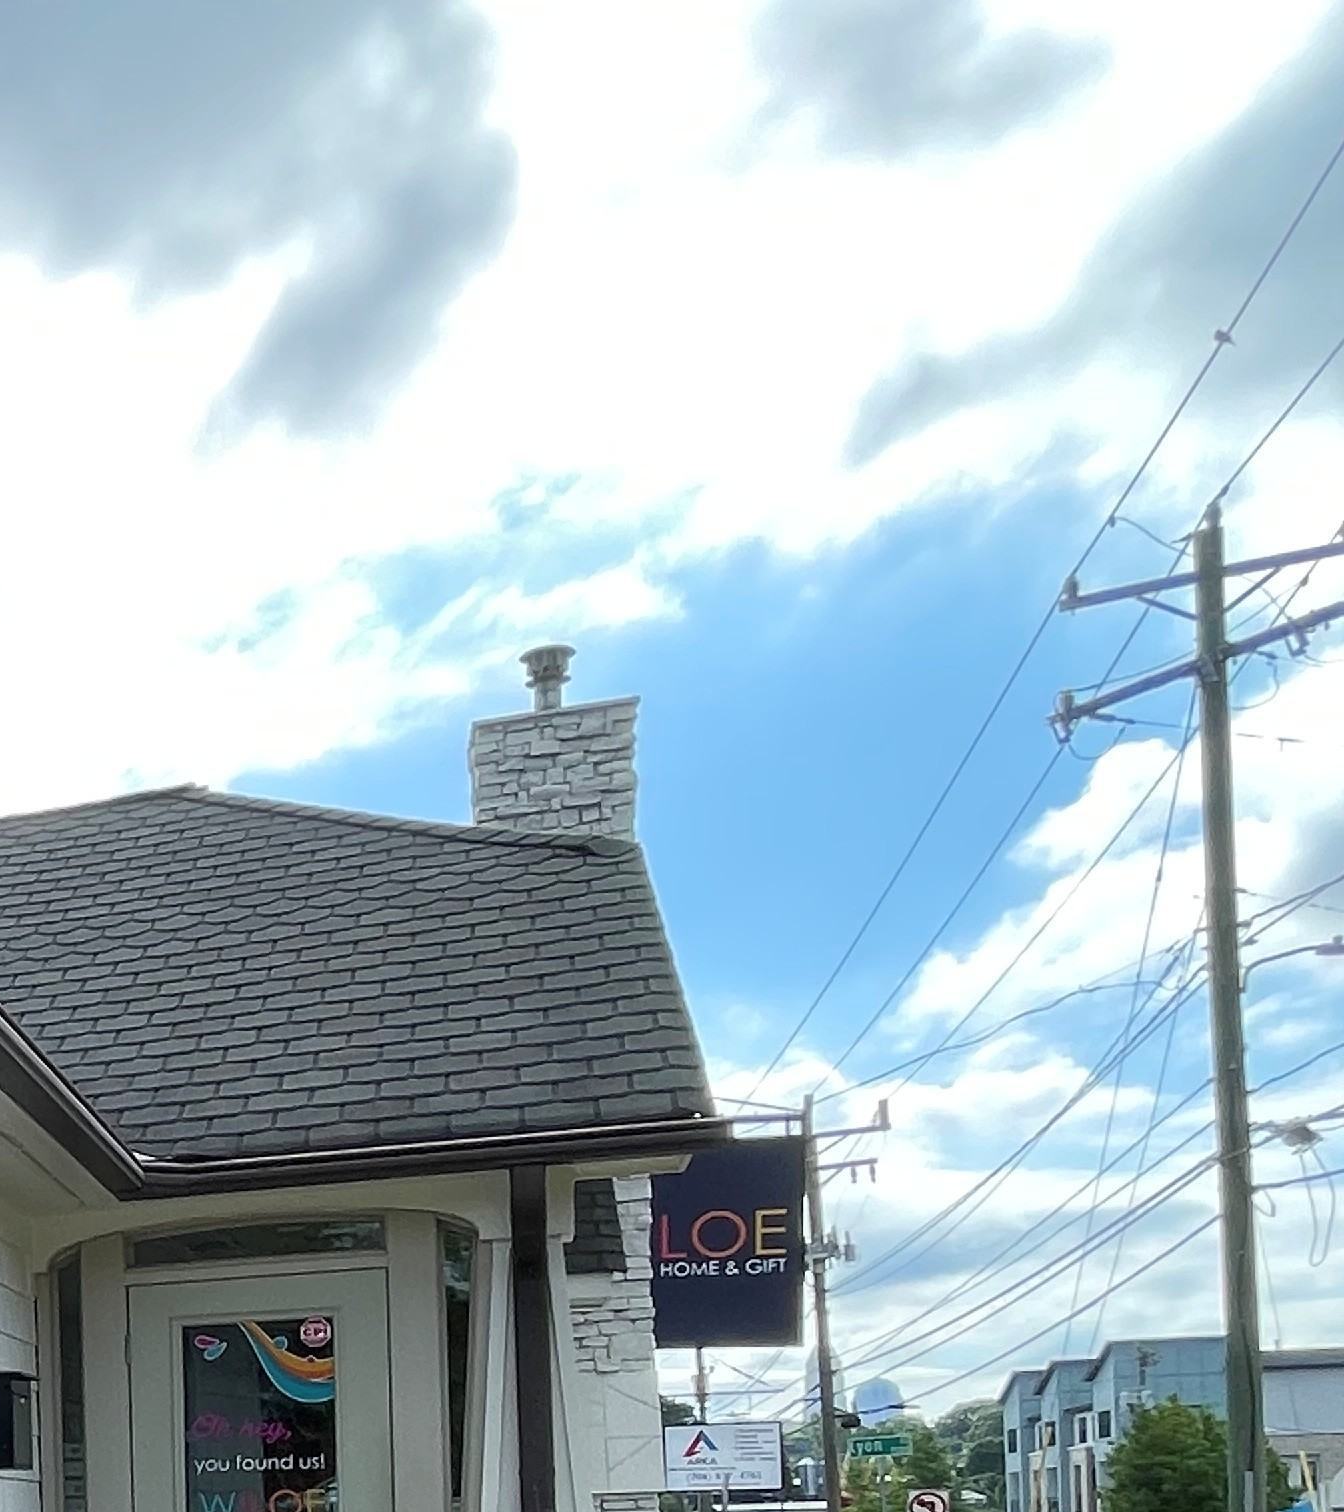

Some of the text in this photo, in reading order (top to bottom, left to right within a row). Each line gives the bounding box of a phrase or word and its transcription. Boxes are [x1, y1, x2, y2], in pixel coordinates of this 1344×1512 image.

[659, 1208, 788, 1259] LOE
[660, 1257, 787, 1278] HOME & GIFT
[194, 1452, 326, 1476] you found us!
